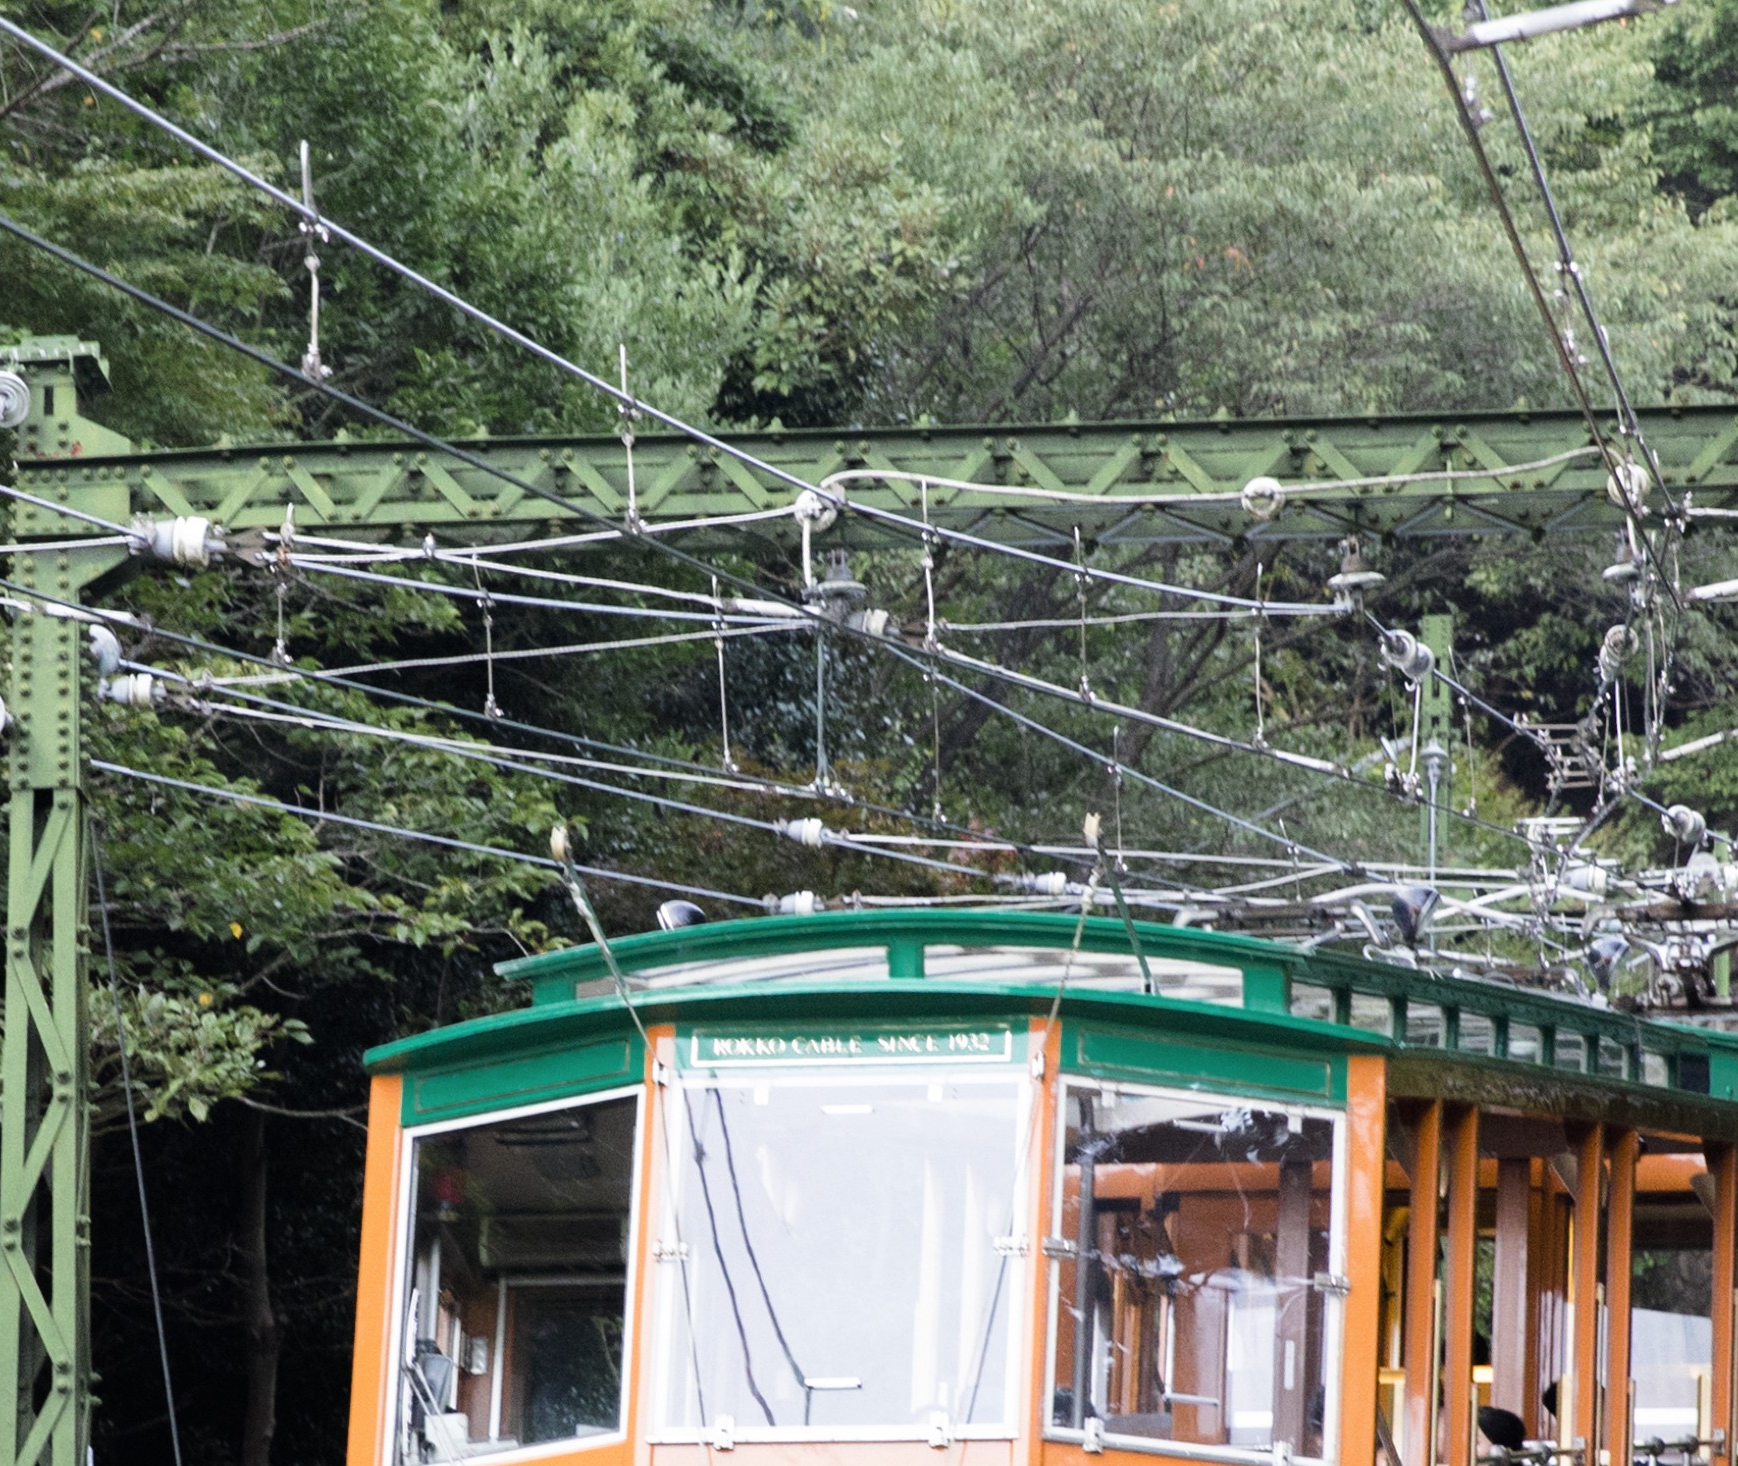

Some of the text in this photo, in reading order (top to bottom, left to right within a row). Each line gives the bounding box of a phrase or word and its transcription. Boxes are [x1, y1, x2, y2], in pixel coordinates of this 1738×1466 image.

[712, 1033, 991, 1056] ROKKO CABLE SINCE 1932
